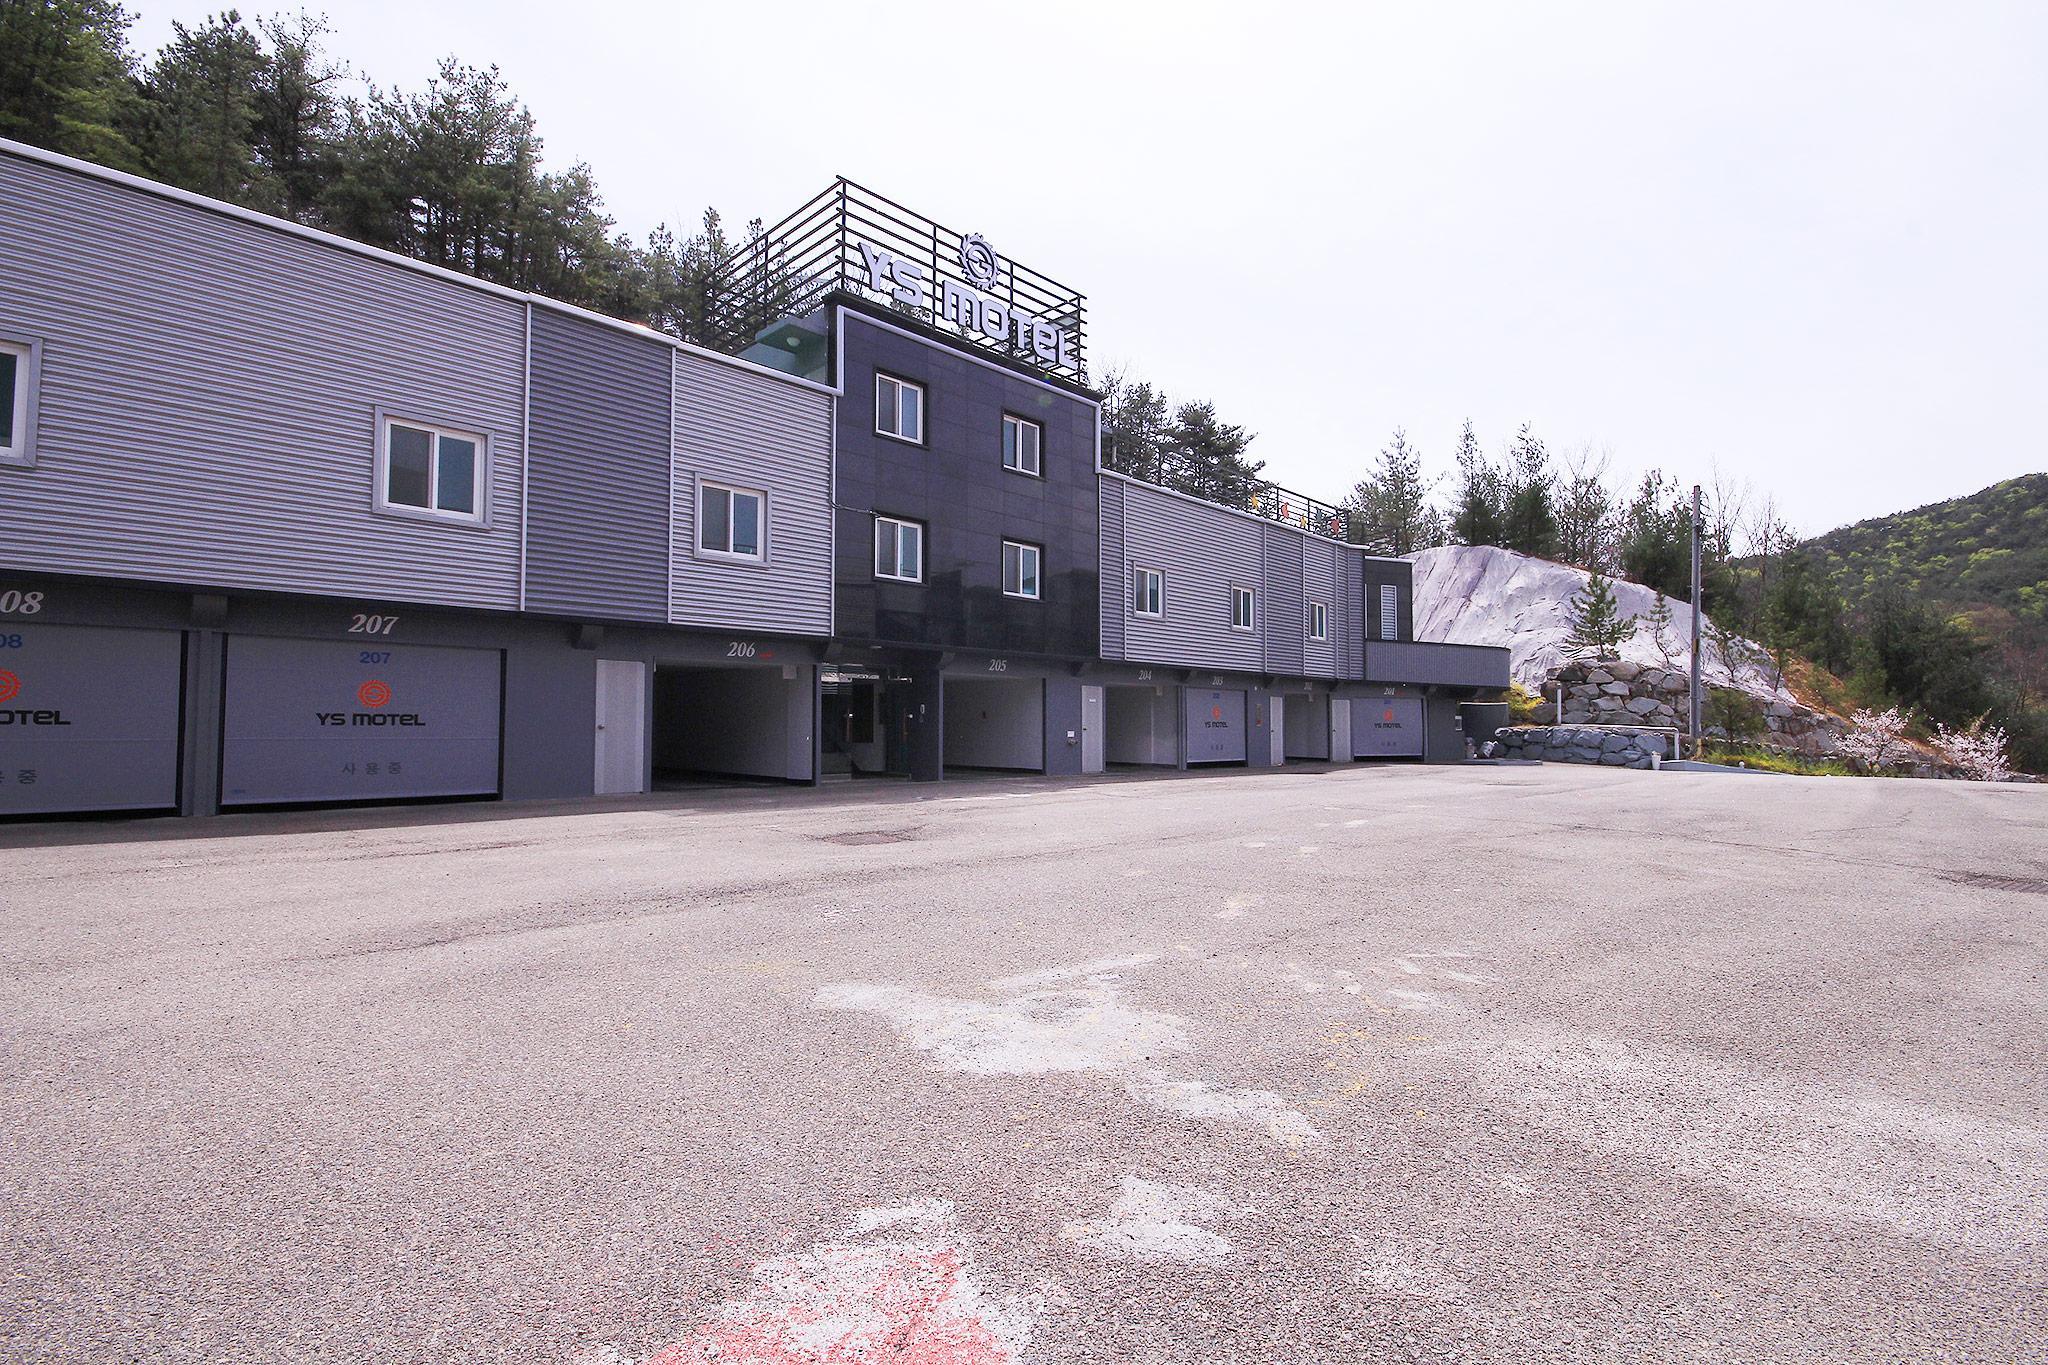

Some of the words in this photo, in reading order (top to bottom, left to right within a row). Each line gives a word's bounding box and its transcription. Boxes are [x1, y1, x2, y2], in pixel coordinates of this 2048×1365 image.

[858, 241, 924, 307] YS
[348, 613, 399, 635] 207
[727, 641, 756, 657] 206
[360, 651, 391, 664] 207
[989, 659, 1007, 672] 205
[316, 713, 346, 726] YS
